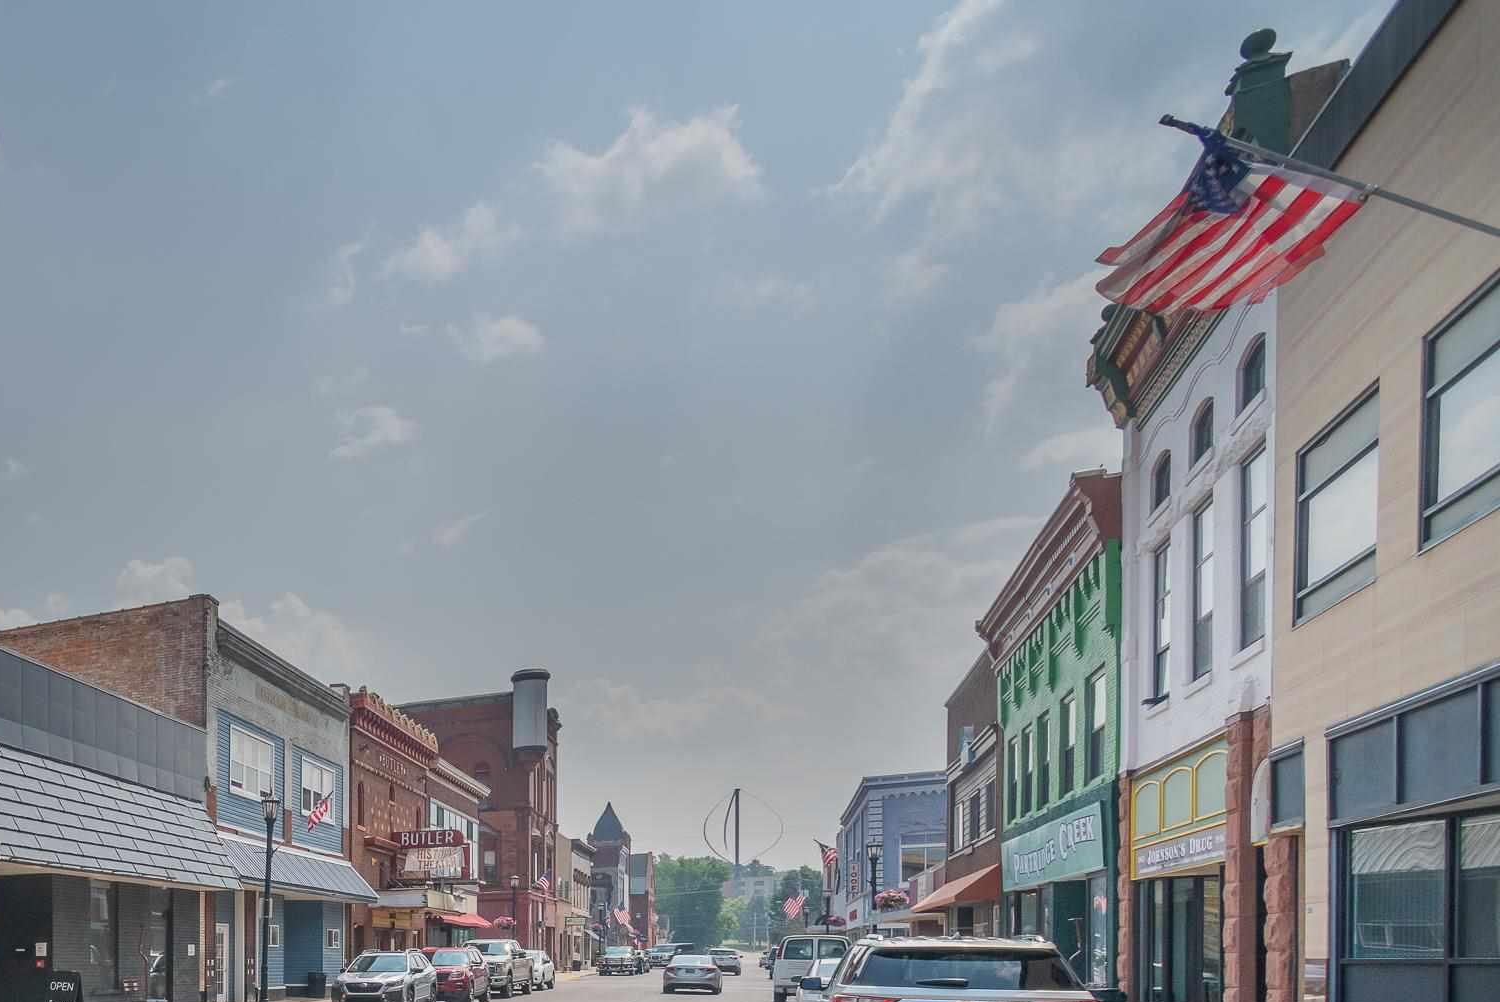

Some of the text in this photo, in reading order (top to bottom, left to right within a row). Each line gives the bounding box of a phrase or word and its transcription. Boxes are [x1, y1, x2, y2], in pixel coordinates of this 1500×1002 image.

[401, 831, 454, 846] BUTLER
[1189, 836, 1213, 854] DRUG
[1013, 815, 1095, 883] PARTRIDGE CREEK
[50, 981, 75, 992] OPEN
